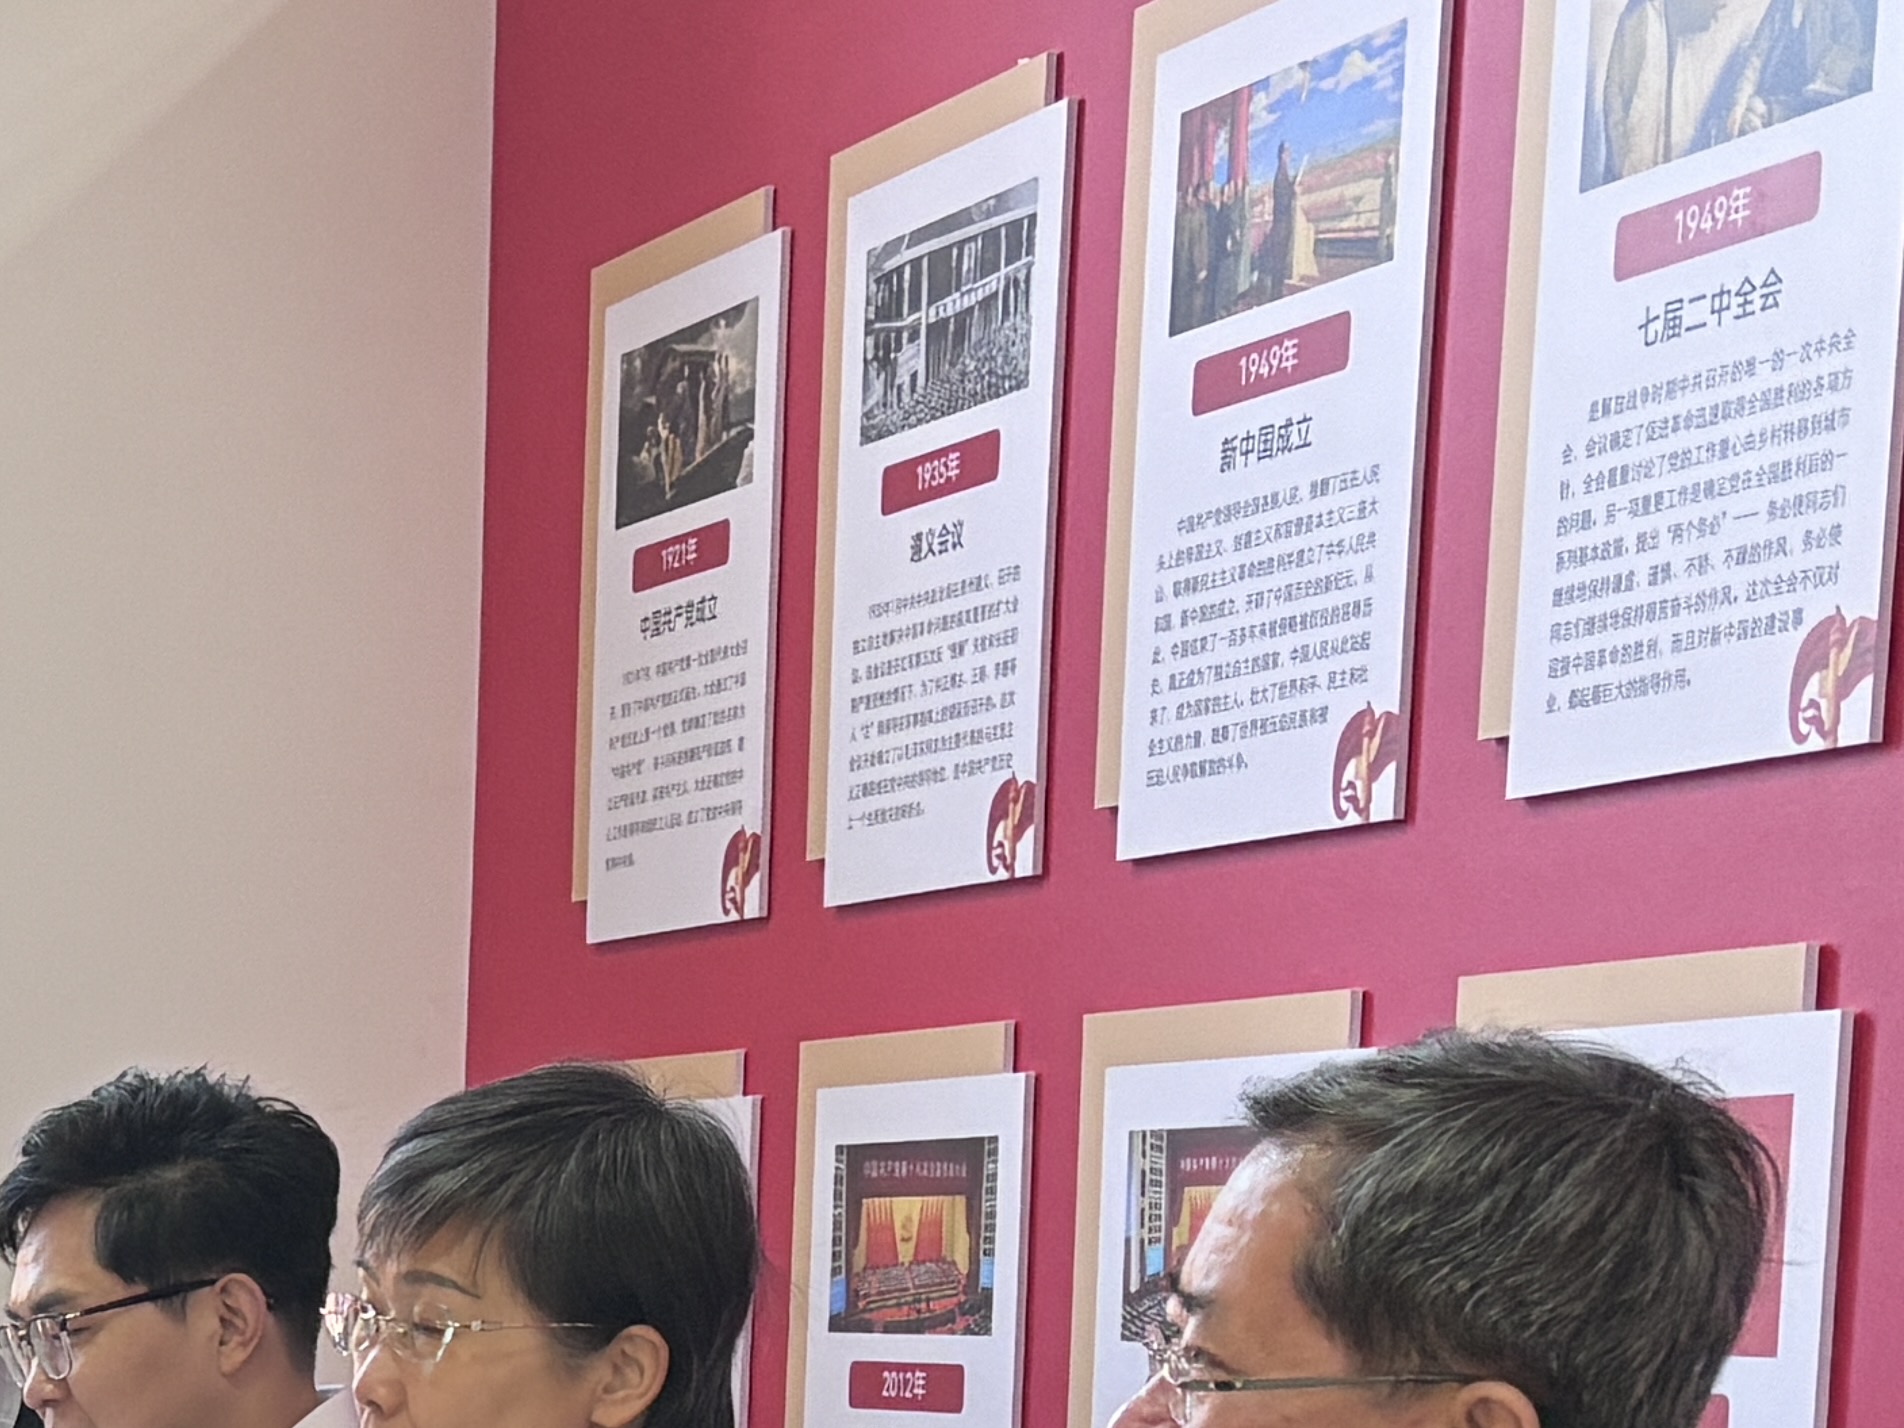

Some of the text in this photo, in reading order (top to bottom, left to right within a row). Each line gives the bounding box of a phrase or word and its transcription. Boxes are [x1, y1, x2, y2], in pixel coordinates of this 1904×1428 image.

[1675, 186, 1752, 244] 1949年
[1638, 266, 1783, 347] 七届二中全会
[1239, 339, 1299, 386] 1949年
[1220, 412, 1313, 474] 新中国成立
[916, 452, 960, 491] 1935年
[661, 537, 698, 572] 1921年
[910, 519, 964, 563] 遵义会议
[640, 594, 719, 640] 中国共产党成立
[881, 1368, 927, 1401] 2012年
